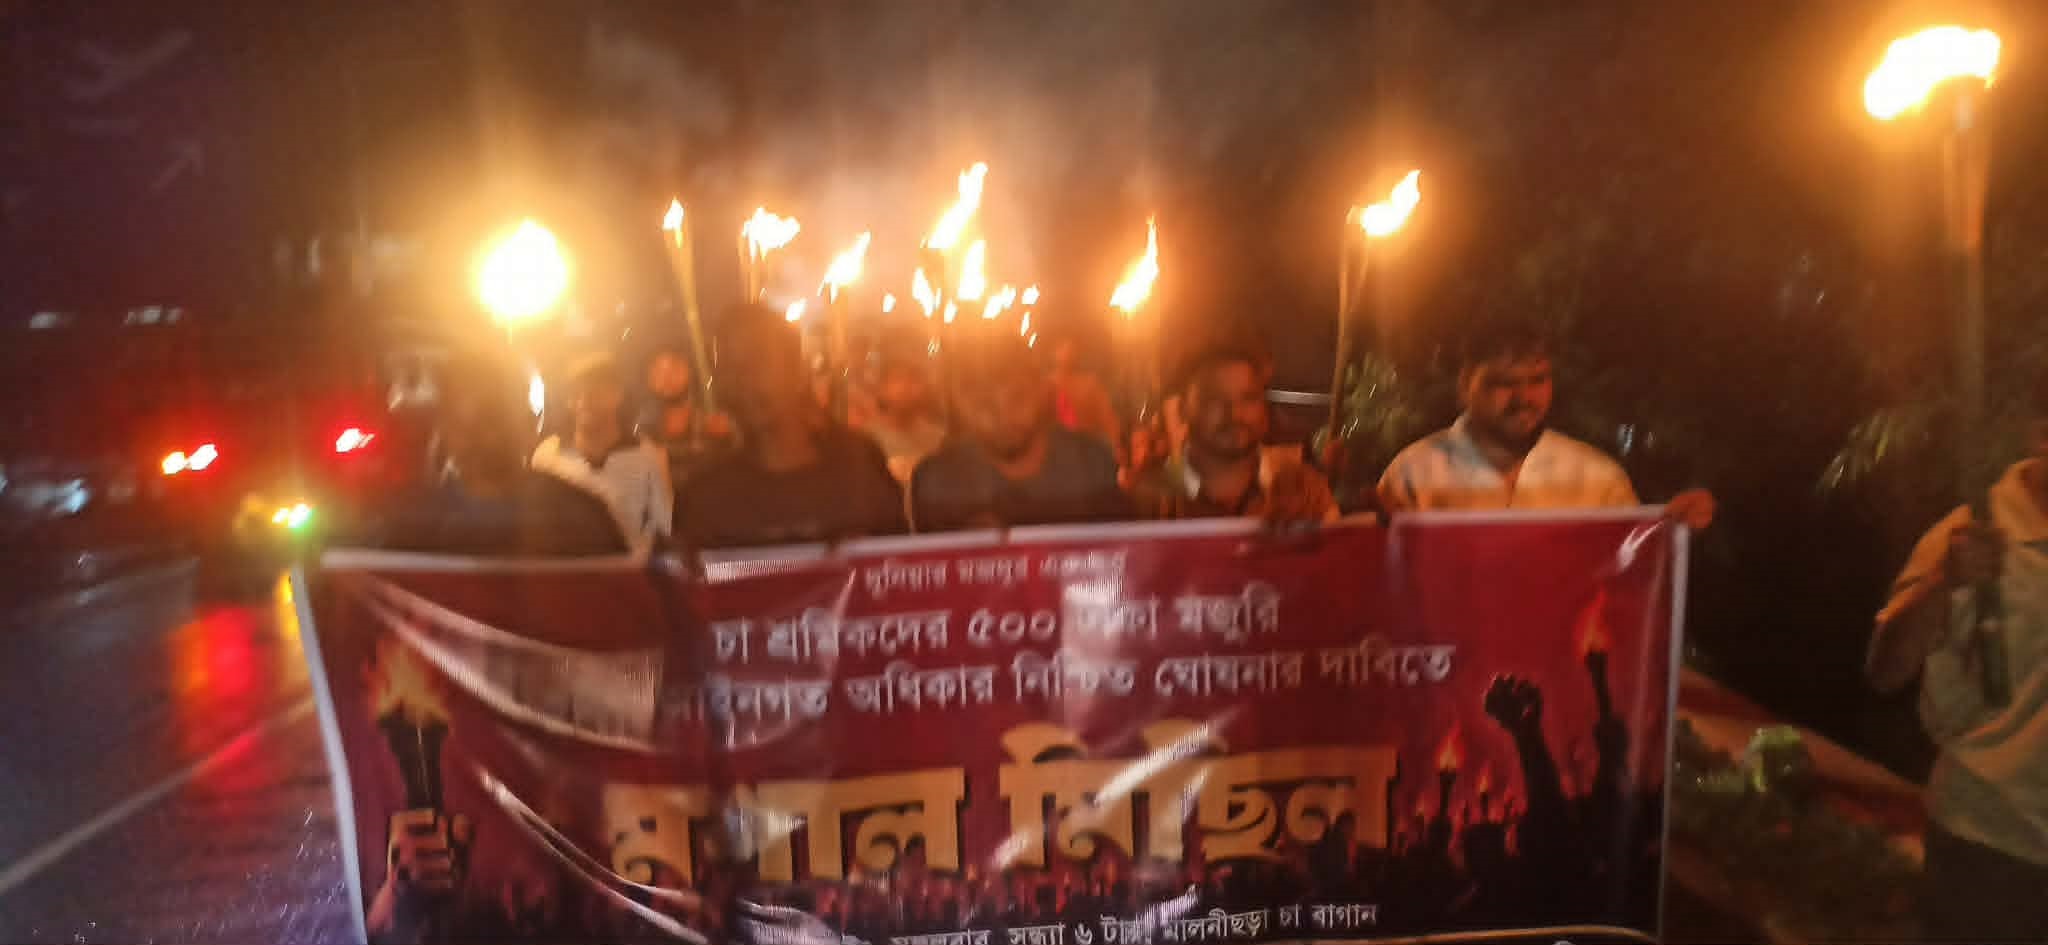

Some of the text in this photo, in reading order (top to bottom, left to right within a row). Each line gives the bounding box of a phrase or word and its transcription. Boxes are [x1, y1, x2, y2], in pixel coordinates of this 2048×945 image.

[710, 614, 752, 664] চা
[968, 608, 1056, 645] ৫০০
[1173, 582, 1281, 644] মজুরি
[847, 660, 998, 714] অধিকার
[1074, 923, 1093, 944] ৬
[1279, 903, 1303, 927] চা
[1311, 903, 1377, 929] বাগান
